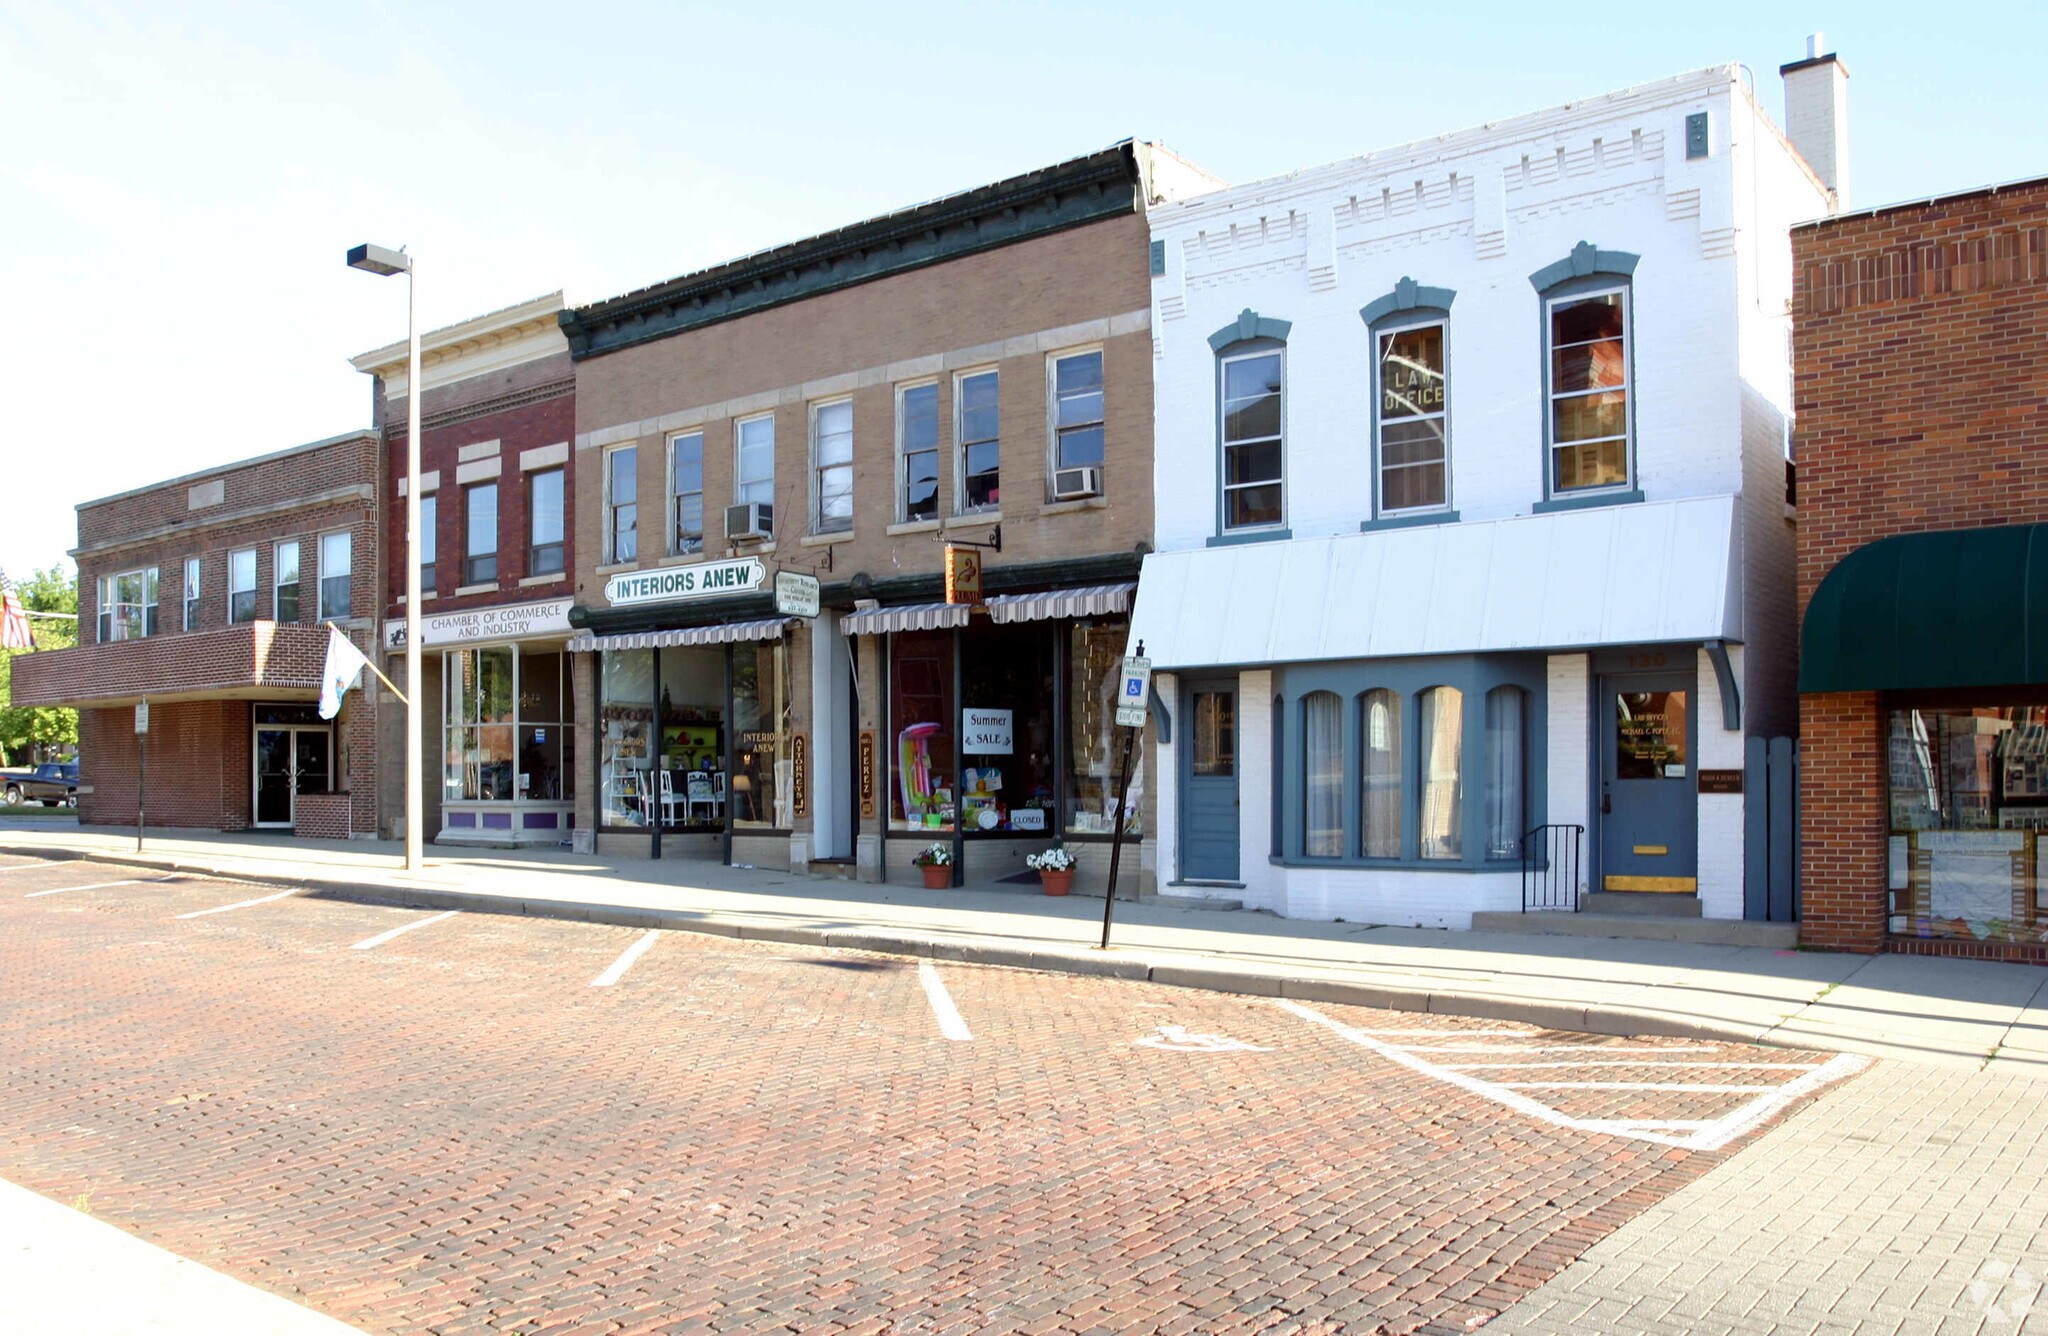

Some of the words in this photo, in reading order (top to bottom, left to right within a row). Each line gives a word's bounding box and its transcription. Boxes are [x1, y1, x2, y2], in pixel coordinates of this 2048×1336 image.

[1395, 369, 1431, 388] LAW
[1384, 387, 1444, 410] OFFICE
[616, 572, 695, 599] INTERIORS
[702, 566, 750, 589] ANEW
[431, 614, 480, 630] CHAMBER
[483, 613, 496, 624] OF
[500, 605, 561, 622] COMMERCE
[458, 627, 480, 638] AND
[483, 620, 531, 635] INDUSTRY
[1124, 669, 1147, 678] PARKING
[970, 714, 1007, 727] Summer
[743, 732, 782, 744] INTERIOR
[976, 733, 1001, 744] SALE
[752, 743, 775, 753] ANEW
[795, 739, 803, 799] ATTORNEYS
[1013, 815, 1041, 824] CLOSED
